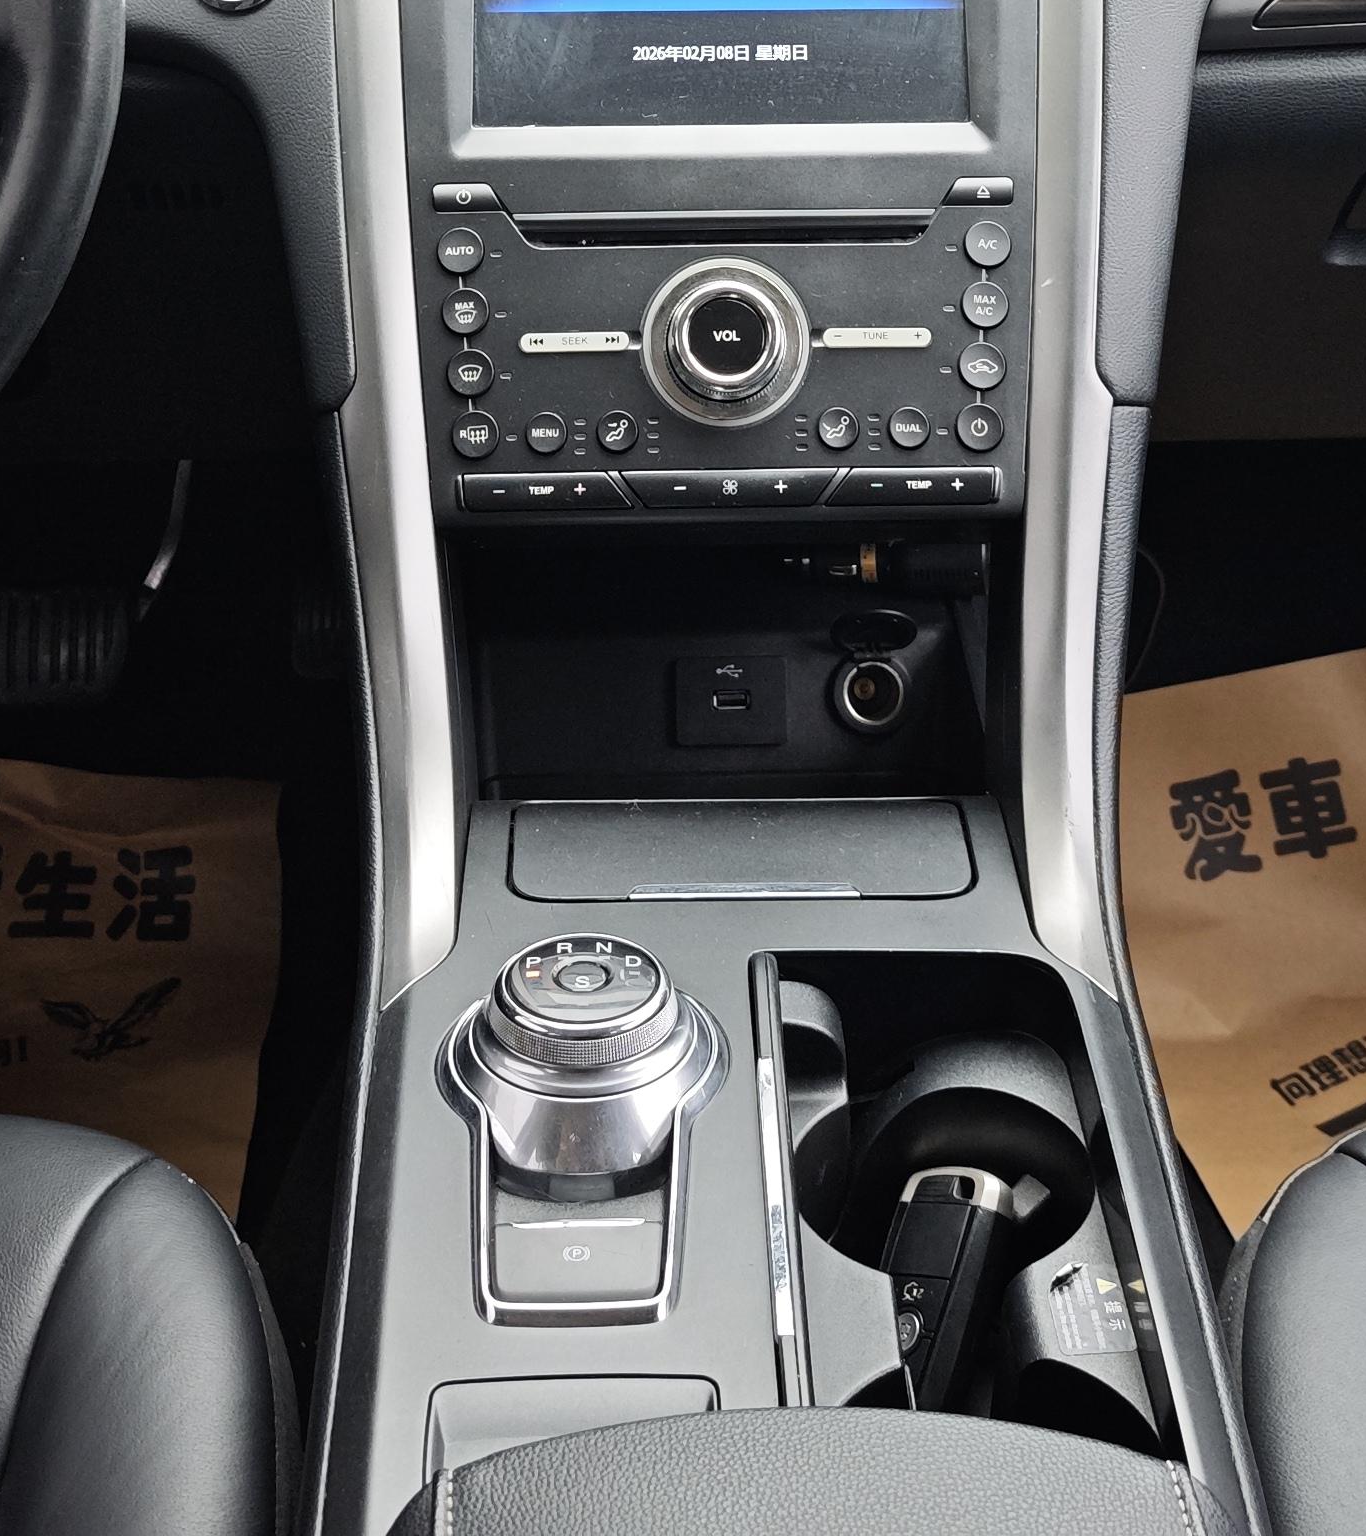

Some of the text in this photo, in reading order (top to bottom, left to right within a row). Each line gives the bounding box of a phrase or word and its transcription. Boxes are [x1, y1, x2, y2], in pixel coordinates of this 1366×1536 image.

[632, 44, 808, 63] 2026年02月08日 星期日
[977, 238, 998, 251] A/C
[444, 245, 475, 256] AUTO
[973, 294, 997, 305] MAX
[454, 301, 475, 311] MAX
[975, 305, 994, 316] A/C
[561, 336, 589, 346] SEEK
[712, 329, 741, 342] VOL
[862, 331, 889, 341] TUNE
[531, 428, 560, 438] MENU
[895, 422, 923, 433] DUAL
[528, 485, 555, 496] TEMP
[905, 480, 933, 490] TEMP
[556, 942, 573, 954] R
[595, 941, 613, 954] N
[525, 956, 542, 969] P
[625, 955, 642, 968] D
[574, 975, 591, 989] S
